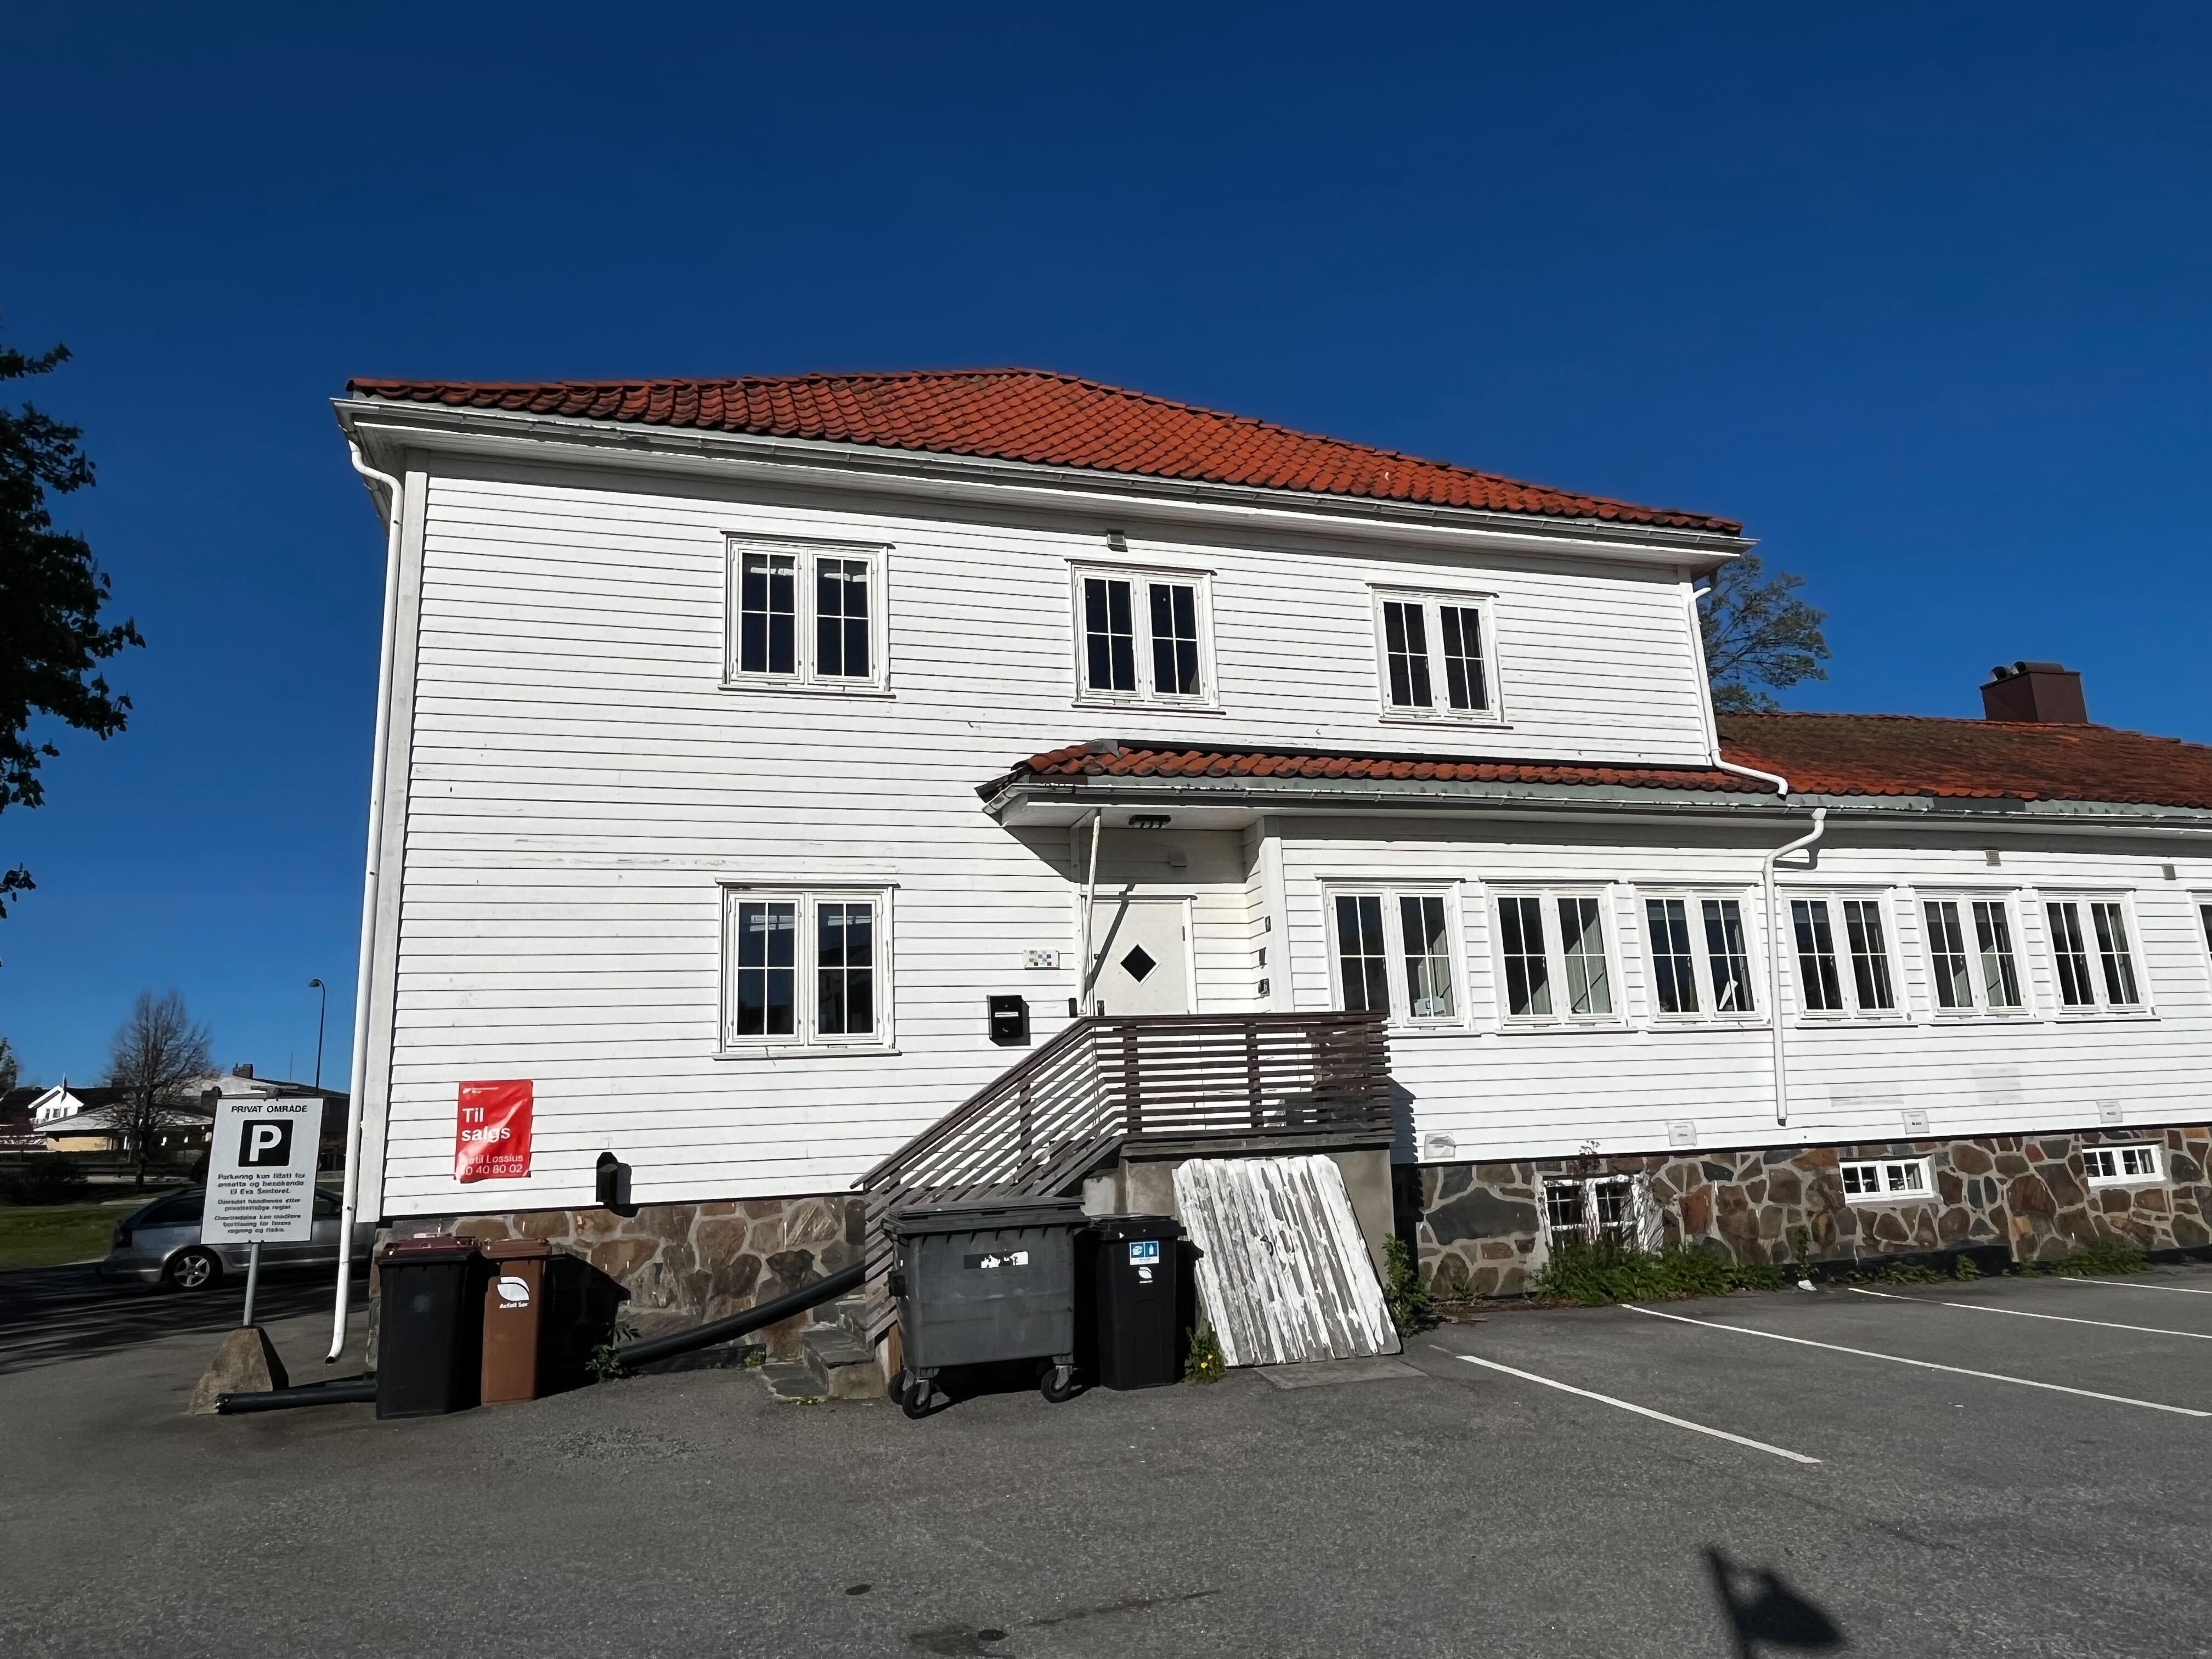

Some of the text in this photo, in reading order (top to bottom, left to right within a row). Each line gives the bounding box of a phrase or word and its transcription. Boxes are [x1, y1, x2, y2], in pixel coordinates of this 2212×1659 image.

[267, 1104, 307, 1113] OMRÅDE
[462, 1108, 484, 1122] Til
[461, 1126, 510, 1143] salgs
[249, 1125, 282, 1161] P
[486, 1154, 523, 1163] Lossius
[476, 1165, 489, 1173] 40
[493, 1165, 506, 1173] 80
[509, 1164, 523, 1173] 02
